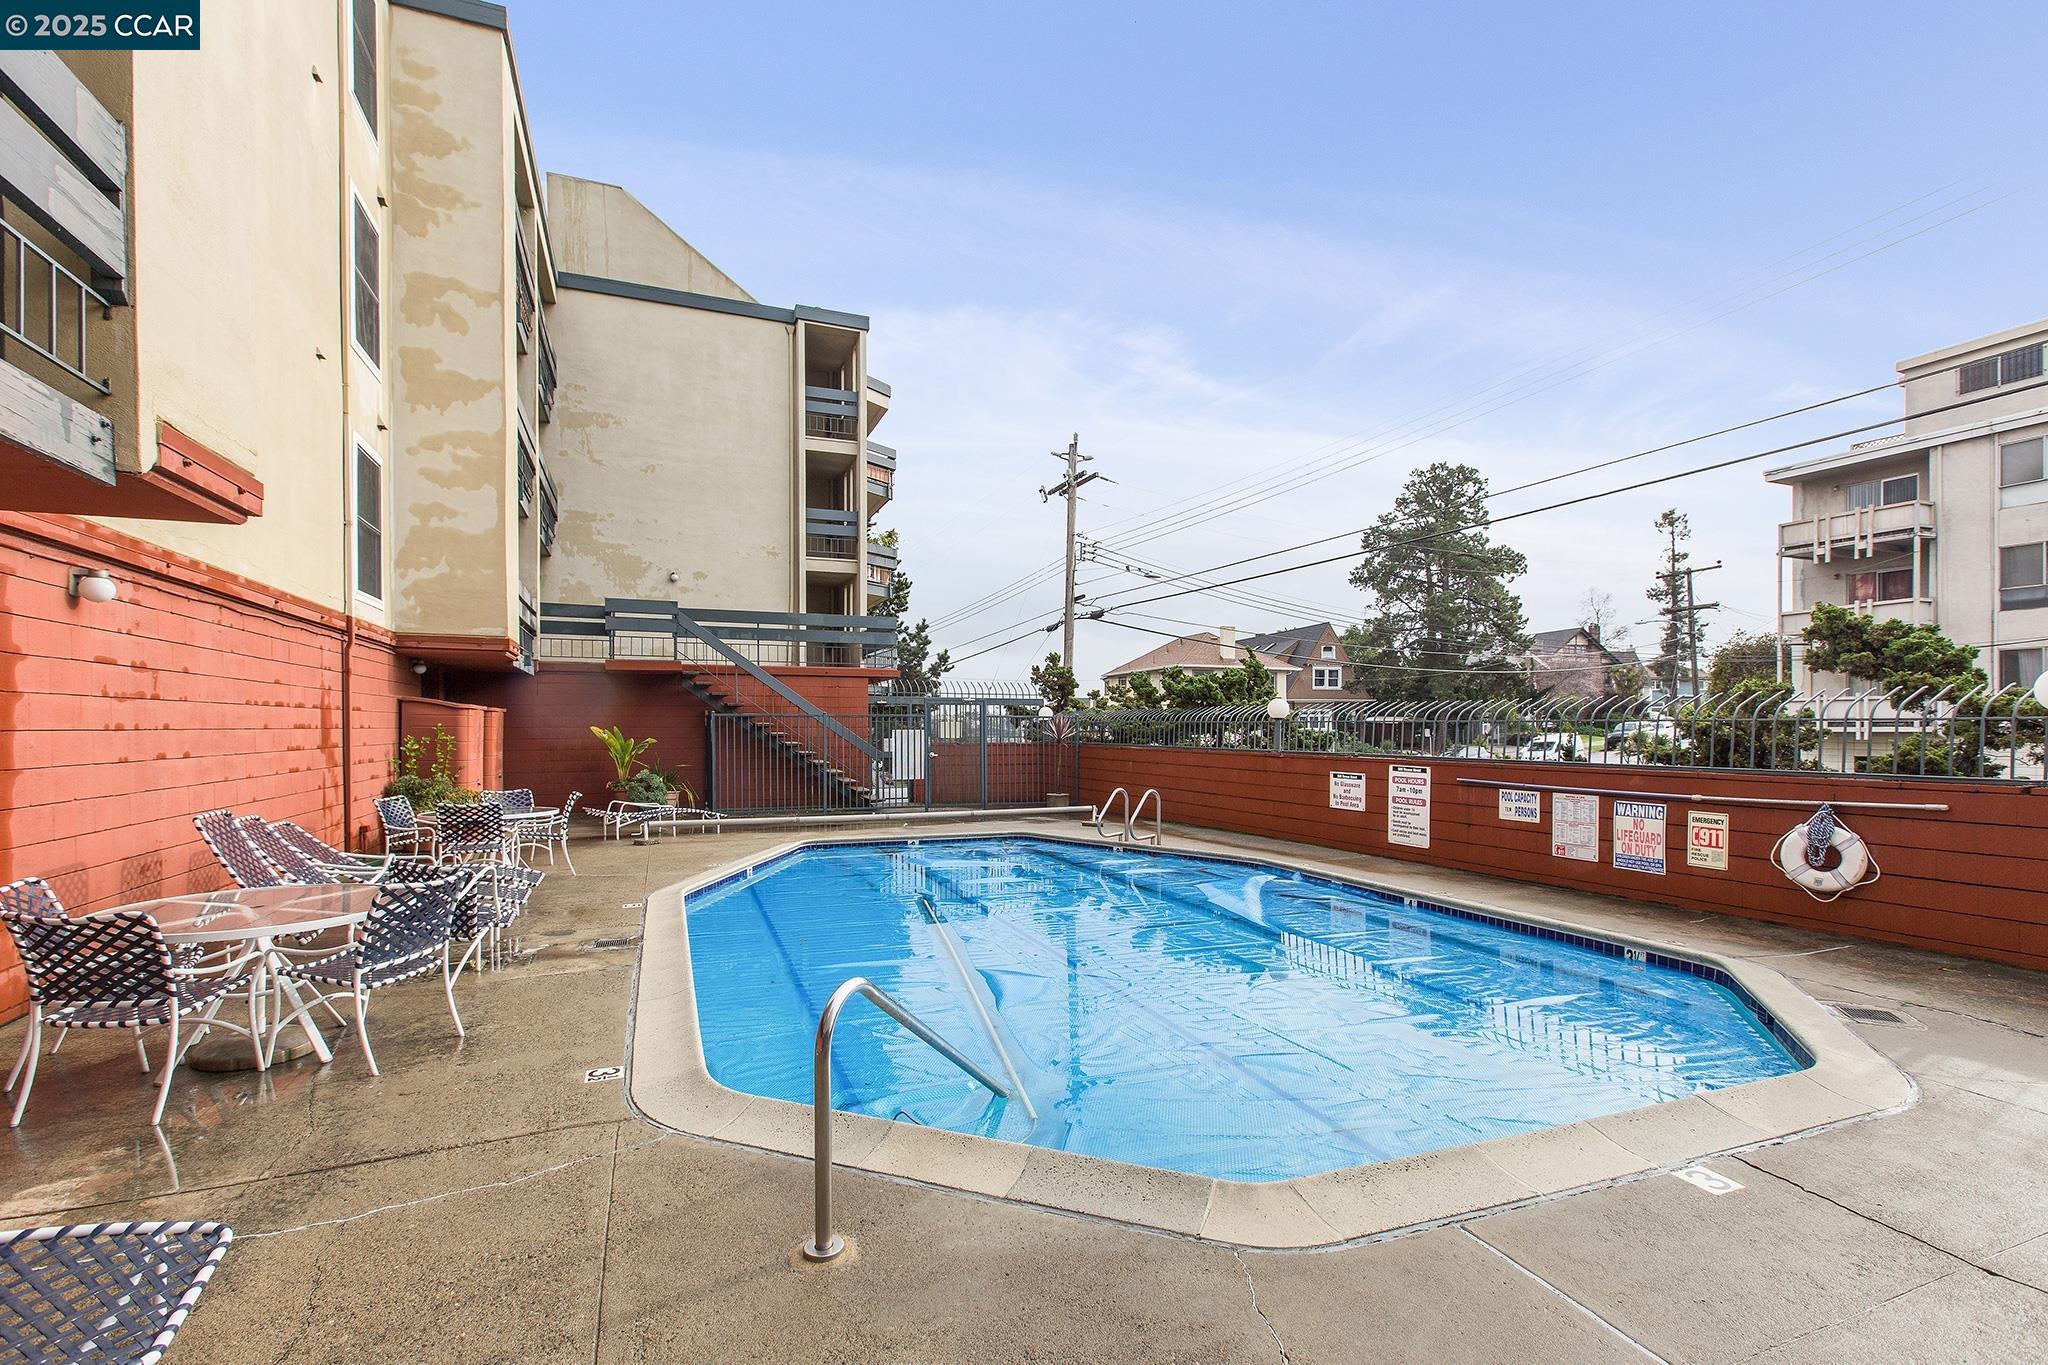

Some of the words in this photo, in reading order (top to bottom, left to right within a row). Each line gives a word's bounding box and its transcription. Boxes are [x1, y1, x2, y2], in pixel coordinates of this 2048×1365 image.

[1501, 791, 1513, 802] POOL
[1514, 792, 1537, 804] CAPACITY
[1515, 806, 1537, 818] PERSONS
[1616, 803, 1664, 819] WARNING
[1633, 818, 1645, 830] NO
[1692, 816, 1725, 825] EMERGENCY
[1616, 829, 1662, 845] LIFEGUARD
[1700, 828, 1724, 848] 911
[1621, 842, 1633, 854] ON
[1635, 844, 1657, 857] DUTY
